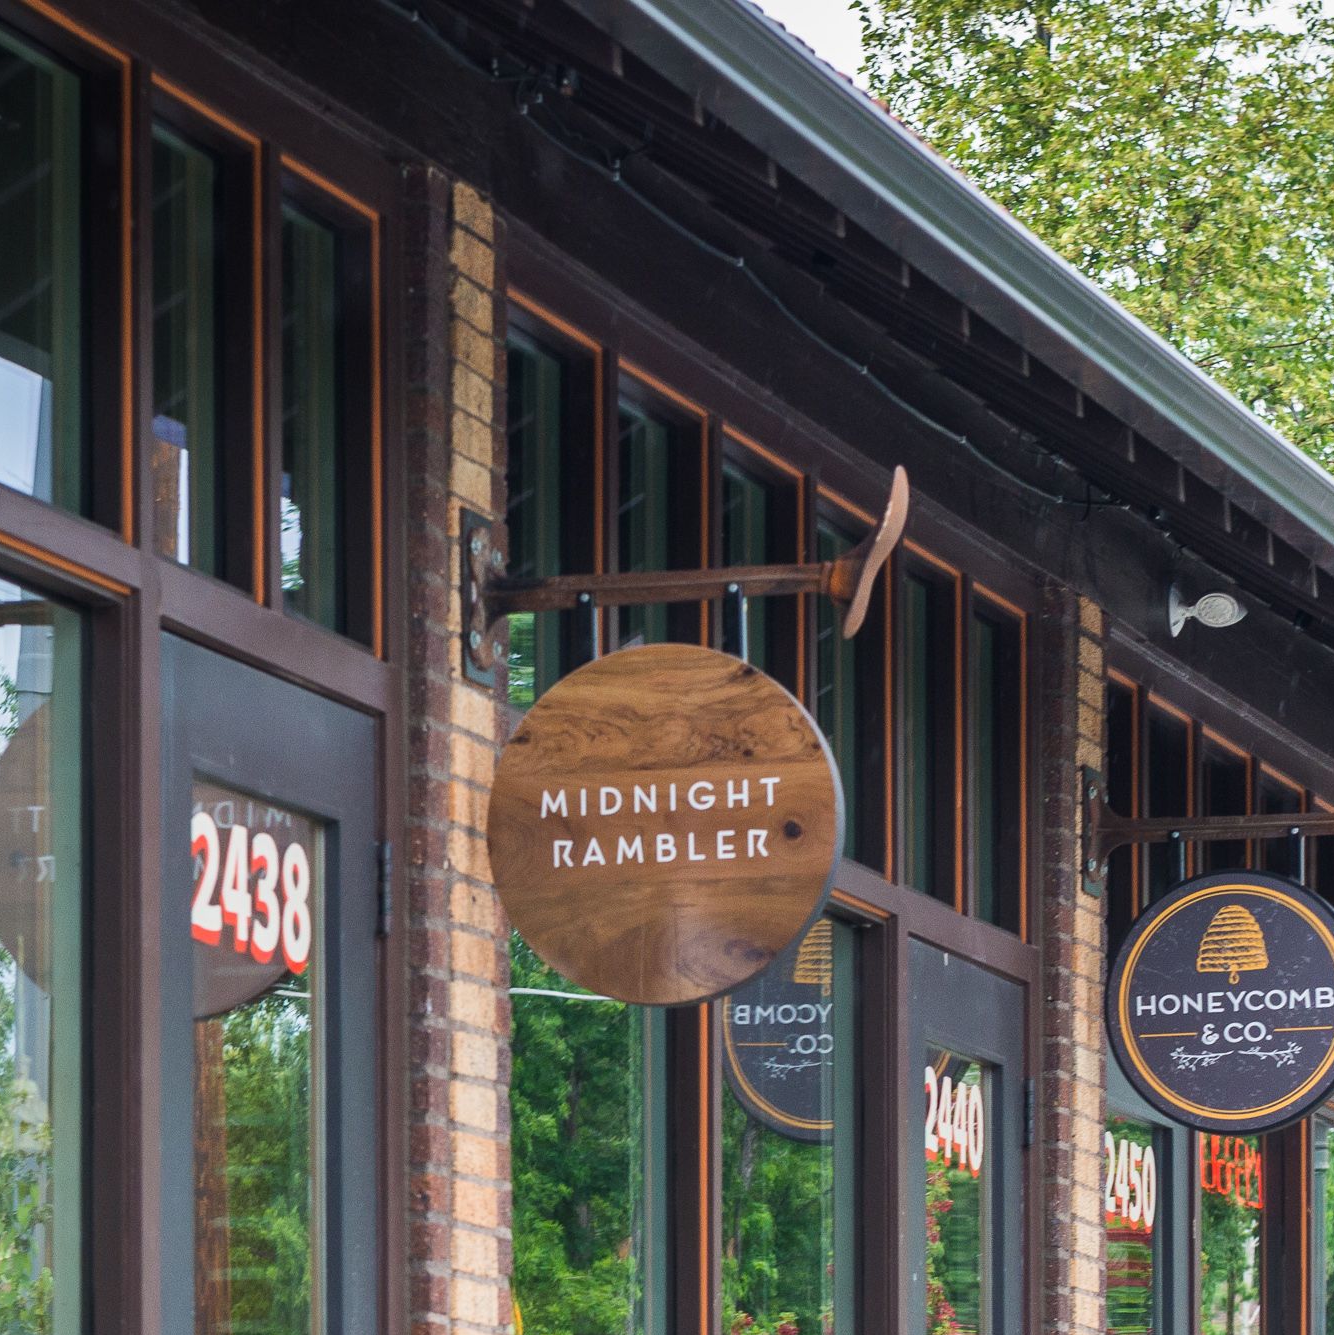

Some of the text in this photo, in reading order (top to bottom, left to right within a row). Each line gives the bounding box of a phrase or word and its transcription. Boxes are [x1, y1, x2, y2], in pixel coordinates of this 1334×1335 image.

[540, 776, 782, 820] MIDNIGHT
[552, 828, 769, 868] RAMBLER
[191, 811, 311, 975] 2438
[1200, 1020, 1273, 1045] & CO.
[924, 1065, 984, 1179] 2440
[1105, 1131, 1157, 1234] 2450
